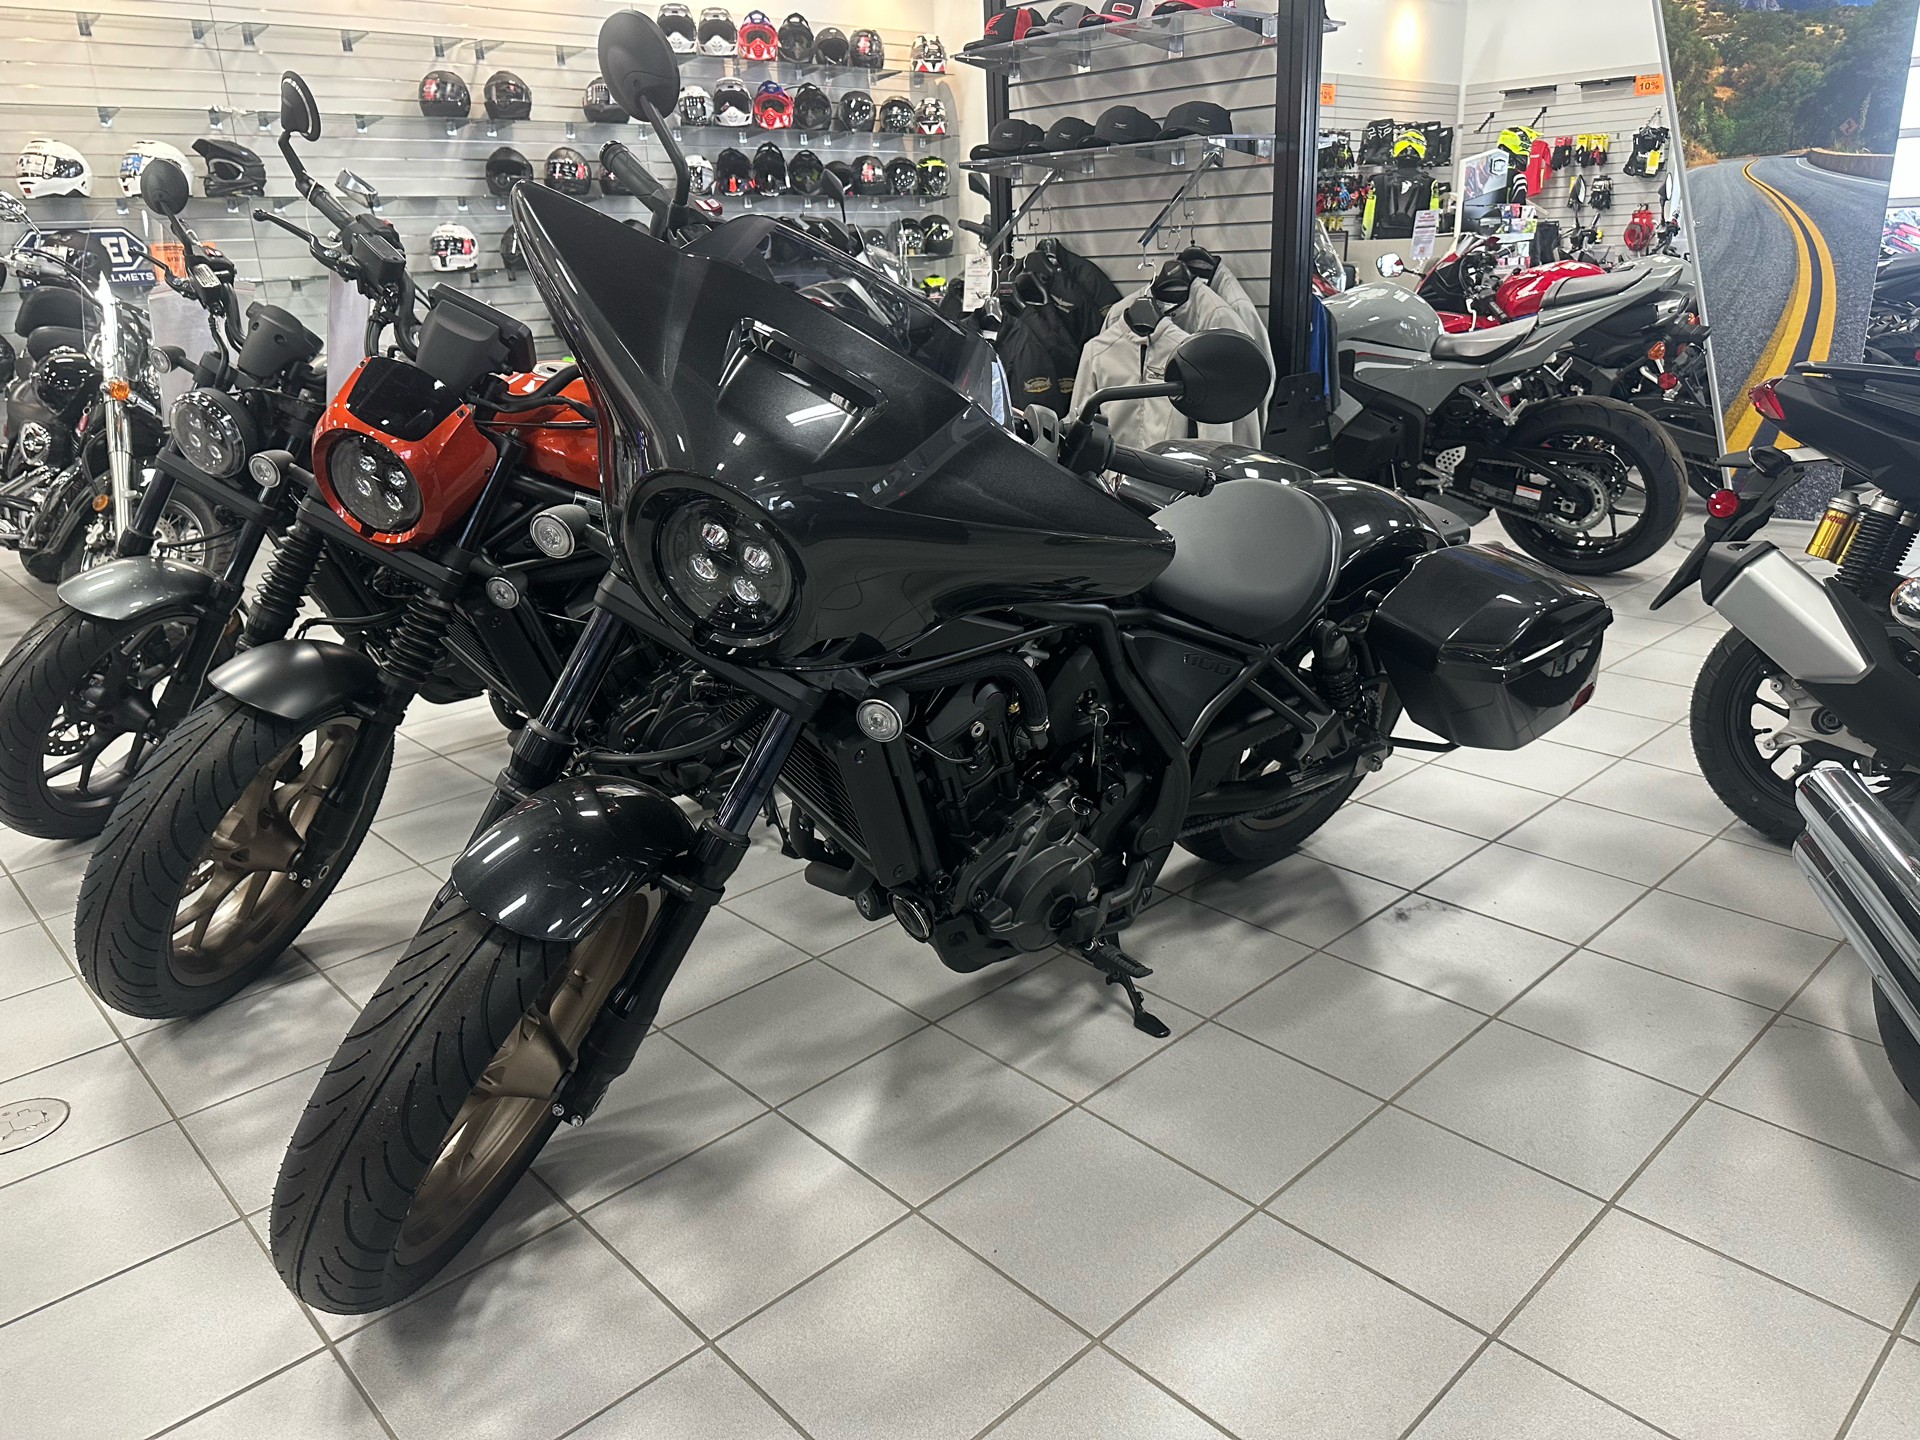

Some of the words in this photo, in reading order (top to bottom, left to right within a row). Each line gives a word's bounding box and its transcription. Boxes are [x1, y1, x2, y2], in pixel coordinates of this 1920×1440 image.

[1639, 81, 1660, 91] 10%
[107, 270, 156, 283] LMETS
[1183, 652, 1232, 677] 1100
